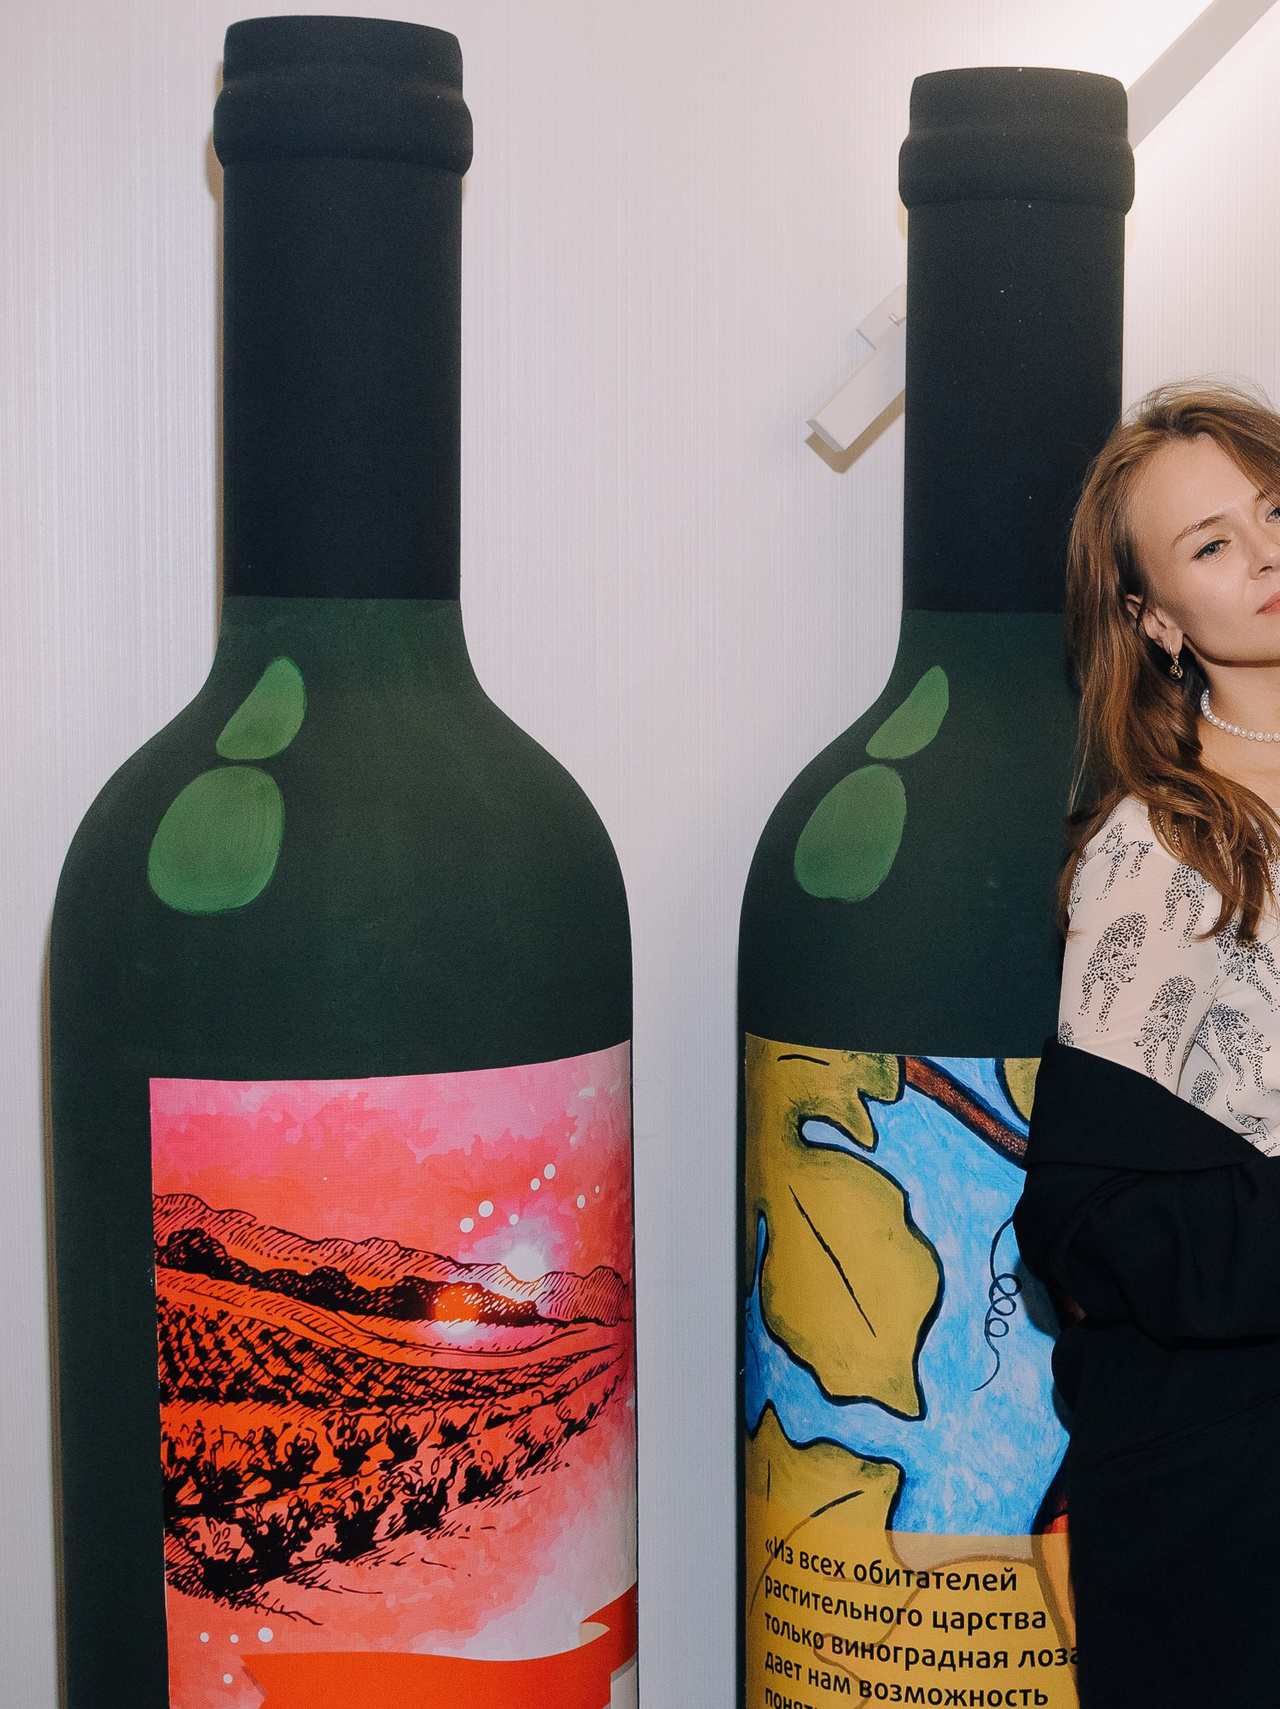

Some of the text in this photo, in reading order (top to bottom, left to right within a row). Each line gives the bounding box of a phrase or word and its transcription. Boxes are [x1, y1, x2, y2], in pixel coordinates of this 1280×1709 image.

[765, 1536, 1017, 1591] «Из всех обитателей
[765, 1575, 1046, 1635] растительного царства
[765, 1612, 824, 1650] только
[832, 1636, 1008, 1670] виноградная
[765, 1650, 1048, 1707] дает нам возможность
